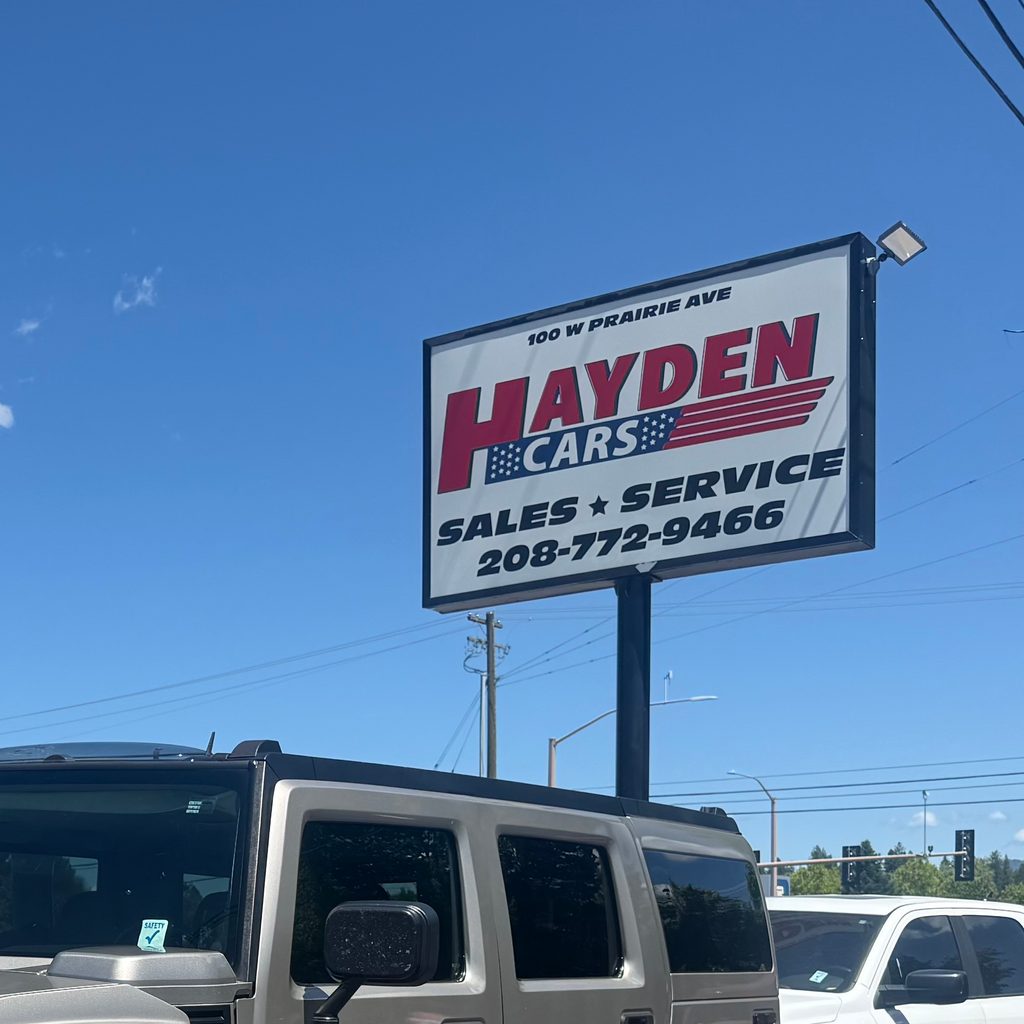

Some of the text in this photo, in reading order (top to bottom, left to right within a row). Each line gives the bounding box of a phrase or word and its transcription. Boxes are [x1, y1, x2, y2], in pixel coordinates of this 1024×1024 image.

[527, 286, 732, 346] 100 W PRAIRIE AVE
[437, 312, 821, 495] HAYDEN
[522, 419, 642, 473] CARS
[437, 447, 846, 547] SALES SERVICE
[476, 500, 786, 577] 208-772-9466
[143, 921, 166, 930] SAFETY
